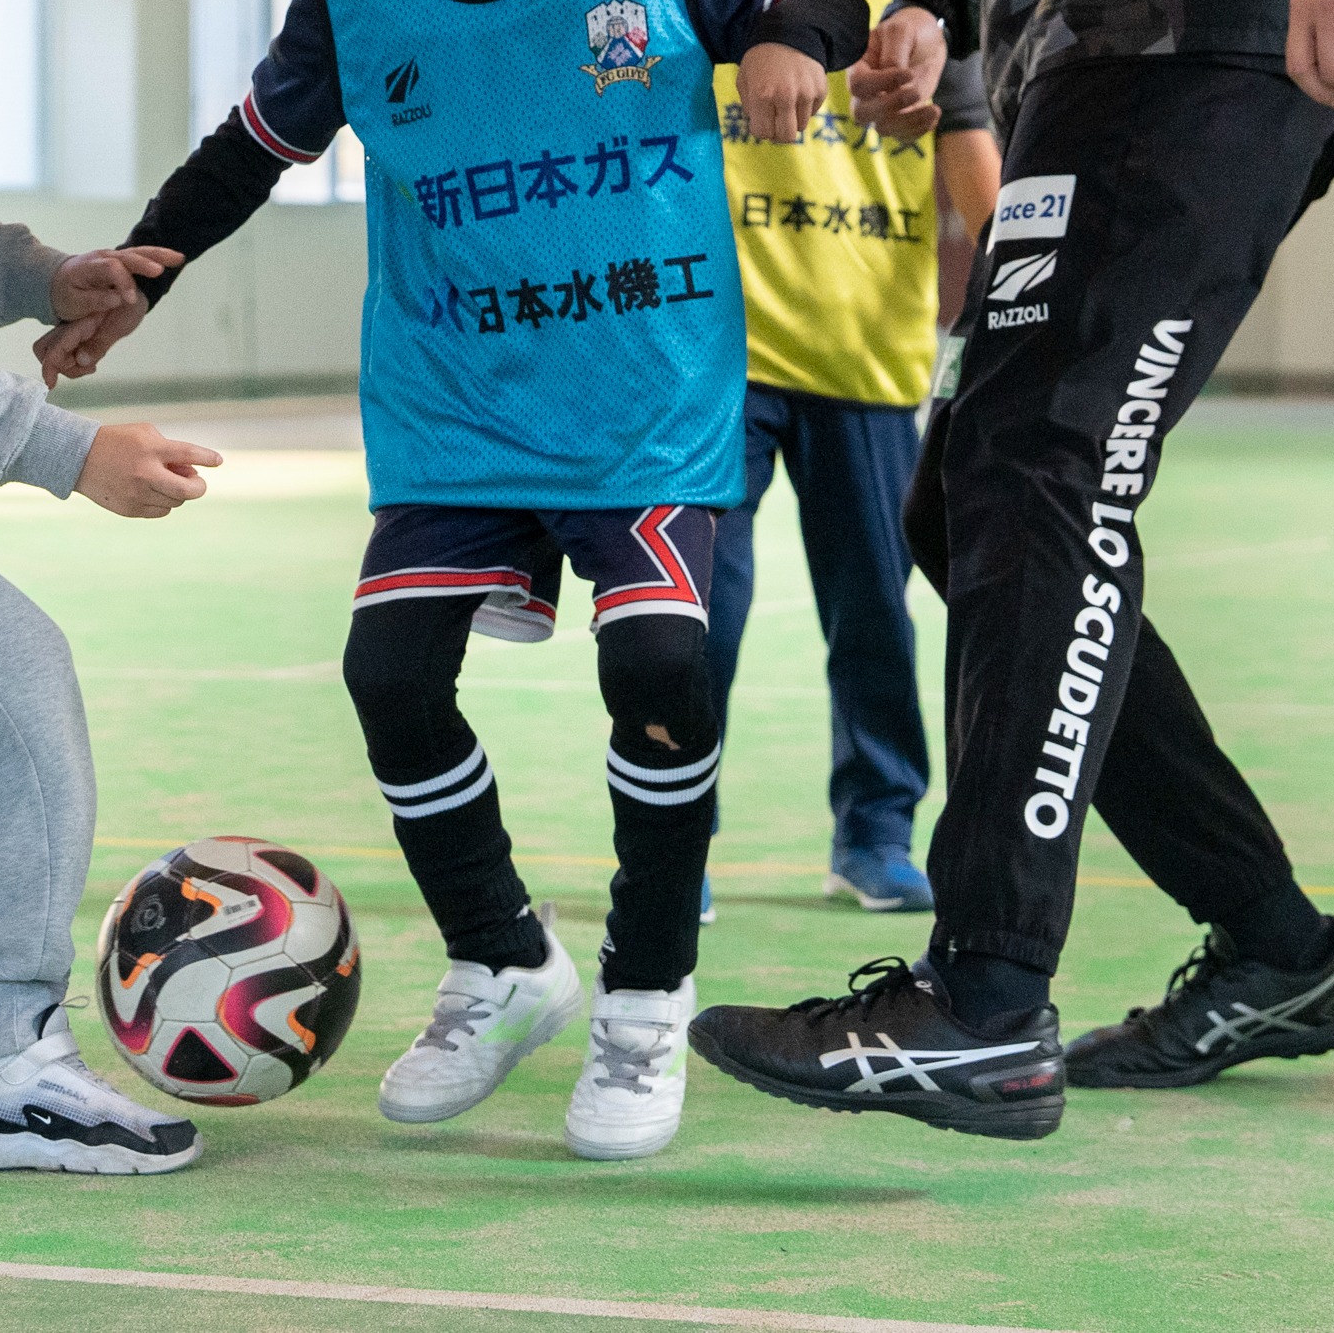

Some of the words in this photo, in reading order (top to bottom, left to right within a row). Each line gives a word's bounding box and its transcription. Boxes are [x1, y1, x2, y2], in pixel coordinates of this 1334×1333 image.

[414, 135, 696, 230] 新日本ガス
[1000, 202, 1036, 223] ace
[1040, 193, 1067, 218] 21
[467, 253, 714, 334] 日本水機工
[987, 302, 1049, 331] RAZZOLI
[1101, 318, 1194, 496] VINCERE
[1088, 502, 1134, 568] LO
[1023, 573, 1122, 840] SCUDETTO
